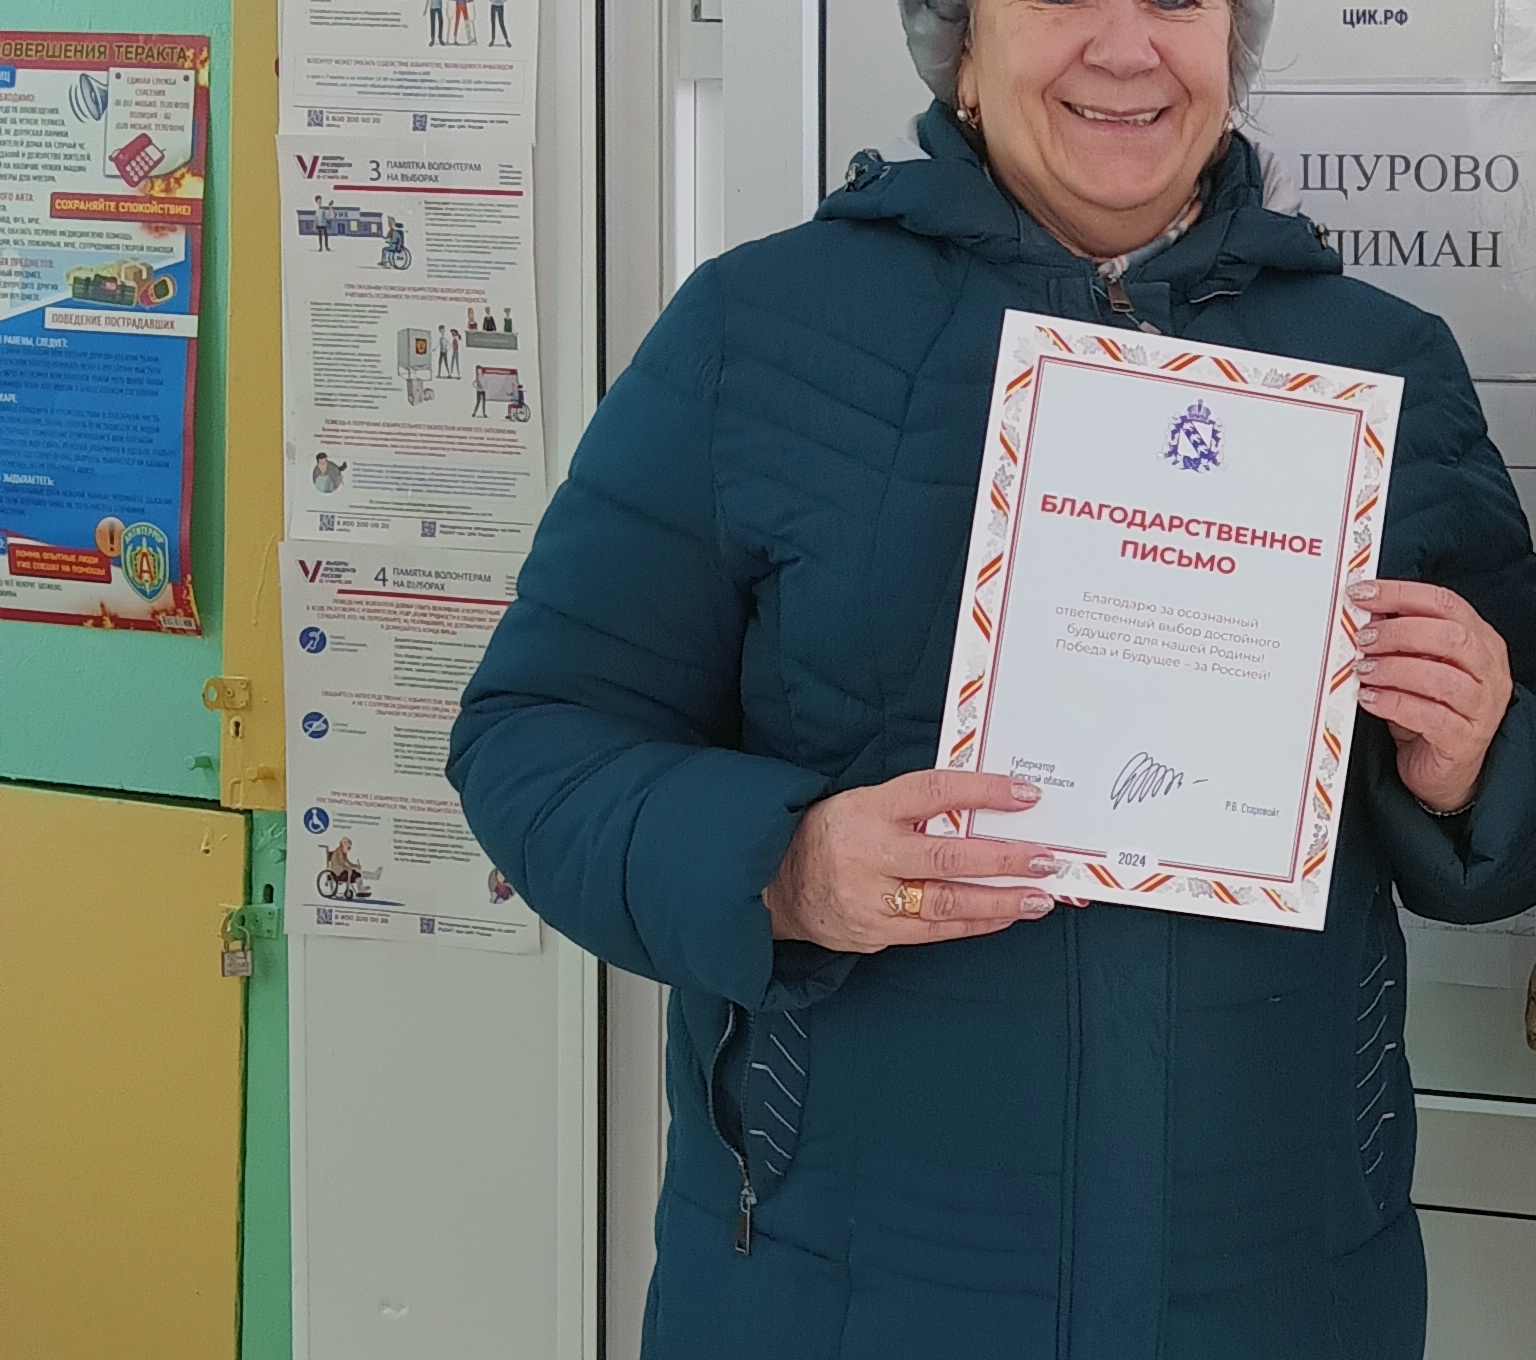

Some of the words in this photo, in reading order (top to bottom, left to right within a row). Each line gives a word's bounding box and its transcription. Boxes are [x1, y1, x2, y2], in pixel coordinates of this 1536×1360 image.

[1342, 8, 1408, 28] ЦИК.РФ
[0, 42, 107, 60] ОВЕРШЕНИЯ
[115, 43, 188, 62] ТЕРАКТА
[369, 160, 381, 181] 3
[386, 161, 426, 170] ПАМЯТКА
[428, 162, 481, 172] ВОЛОНТЕРАМ
[387, 174, 399, 182] НА
[401, 174, 439, 183] ВЫБОРАХ
[1299, 153, 1520, 201] ЩУРОВО
[55, 198, 116, 212] СОХРАНЯЙТЕ
[119, 200, 192, 216] СПОКОЙСТВИЕ!
[52, 313, 102, 327] ПОВЕДЕНИЕ
[104, 315, 175, 330] ПОСТРАДАВШИХ
[1040, 494, 1323, 557] БЛАГОДАРСТВЕННОЕ
[1121, 540, 1236, 575] ПИСЬМО
[374, 567, 388, 587] 4
[393, 567, 432, 578] ПАМЯТКА
[435, 570, 491, 582] ВОЛОНТЕРАМ
[393, 580, 404, 588] НА
[406, 581, 446, 591] ВЫБОРАХ
[1082, 591, 1156, 613] Благодарю
[1160, 606, 1174, 616] за
[1177, 608, 1259, 629] осознанный
[1055, 606, 1155, 630] ответственный
[1158, 622, 1201, 638] выбор
[1203, 629, 1281, 649] достойного
[1067, 622, 1131, 643] будущего
[1133, 635, 1158, 648] для
[1161, 640, 1206, 655] нашей
[1209, 645, 1265, 664] Родины!
[1055, 638, 1107, 656] Победа
[1110, 648, 1118, 657] и
[1122, 648, 1180, 667] Будущее
[1194, 662, 1207, 672] за
[1211, 662, 1270, 682] Россией!
[1011, 755, 1056, 774] Губернатор
[1043, 775, 1075, 788] области
[1241, 802, 1280, 818] Старовойт
[1118, 851, 1146, 868] 2024
